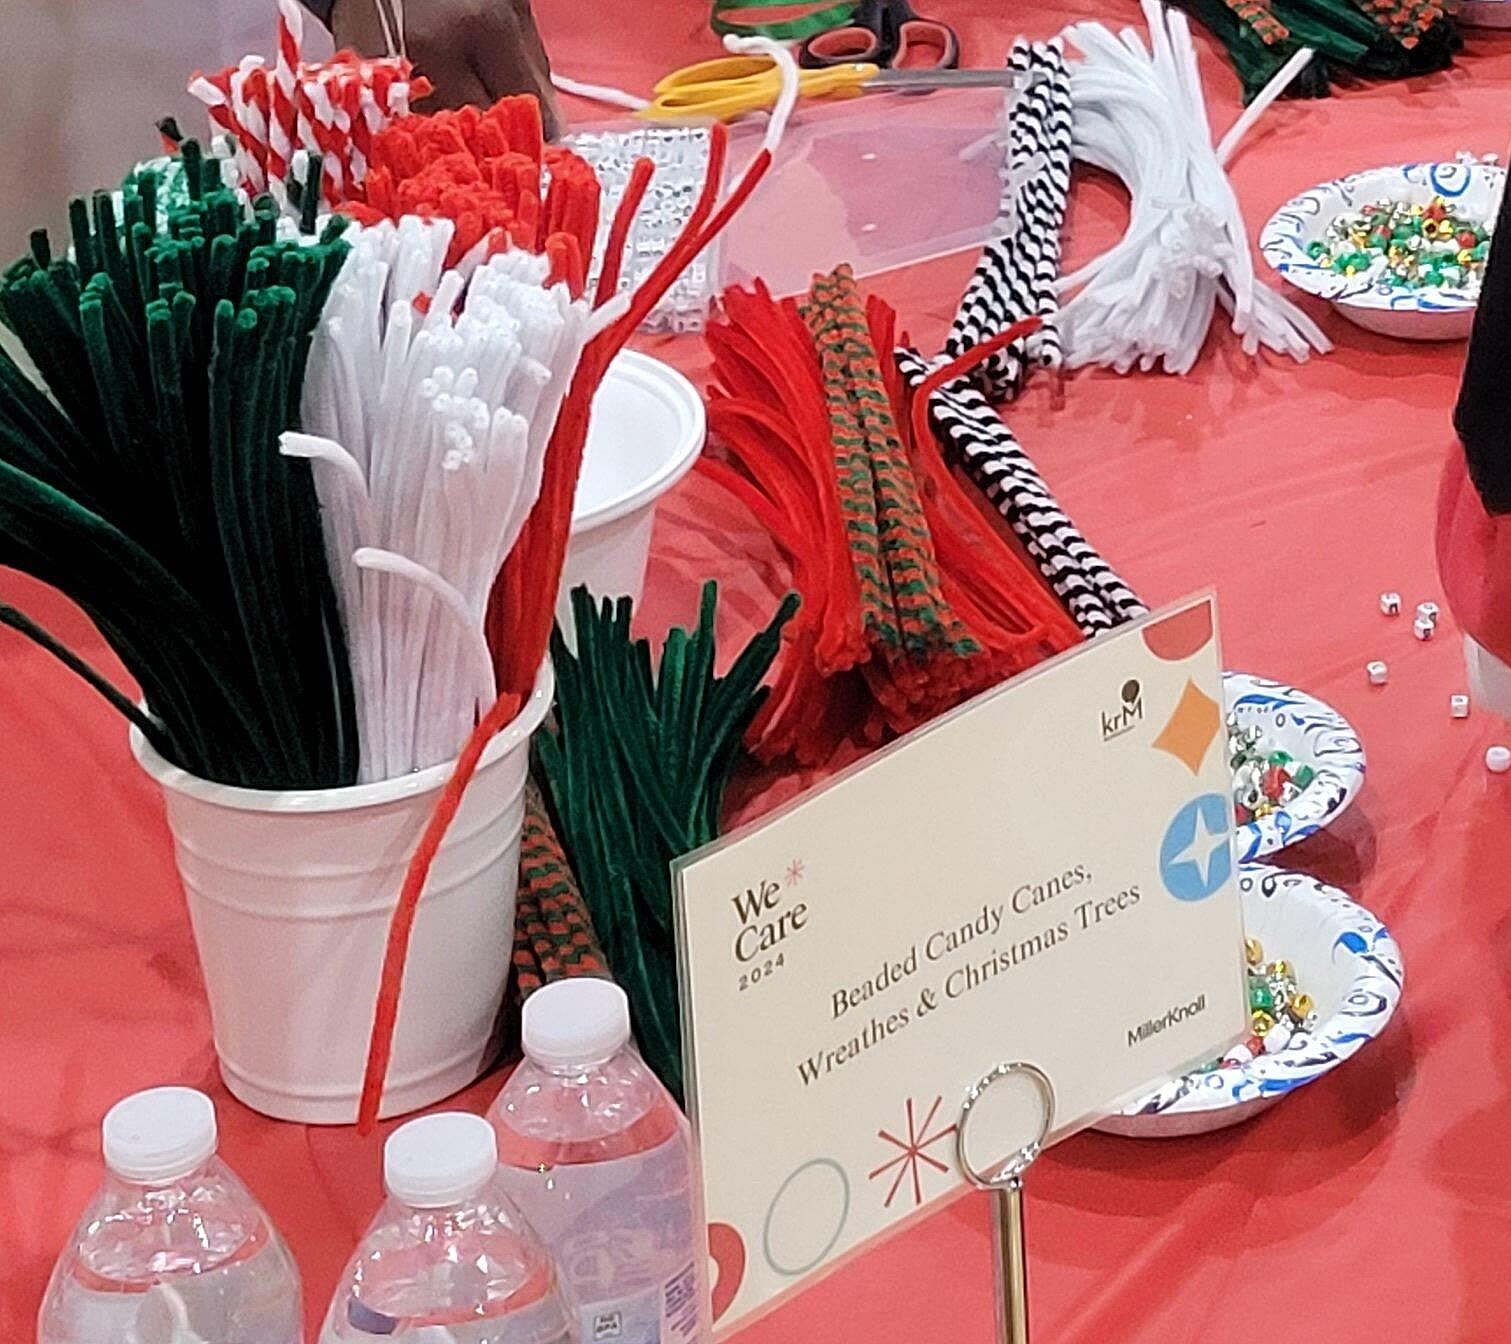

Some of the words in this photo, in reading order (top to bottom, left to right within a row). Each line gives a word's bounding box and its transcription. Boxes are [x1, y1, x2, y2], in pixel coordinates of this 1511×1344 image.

[731, 880, 780, 925] We
[734, 903, 808, 962] Care
[831, 945, 918, 1020] Beaded
[925, 904, 1003, 962] Candy
[1012, 864, 1092, 914] Canes,
[738, 953, 785, 992] 2024
[797, 1007, 909, 1086] Wreathes
[916, 988, 939, 1017] &
[945, 922, 1069, 998] Christmas
[1074, 885, 1141, 930] Trees
[1127, 994, 1206, 1047] MillerKnoll
